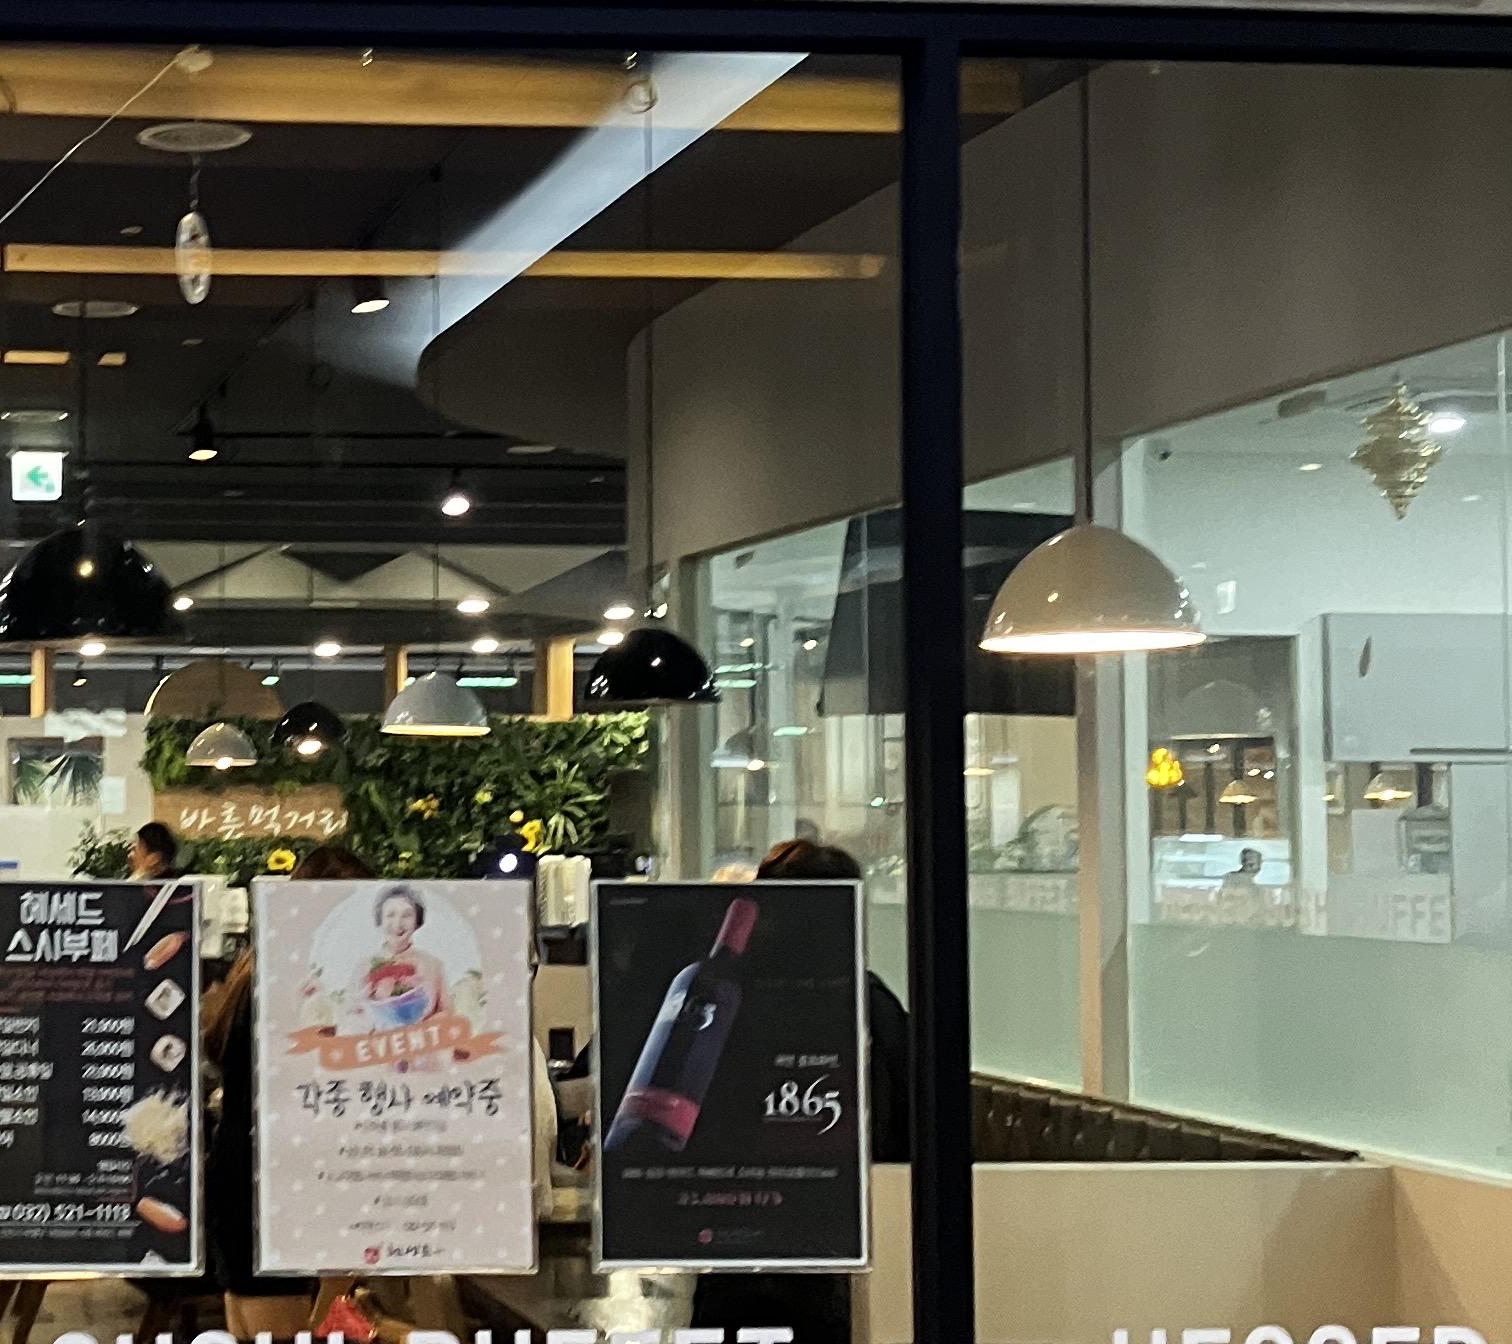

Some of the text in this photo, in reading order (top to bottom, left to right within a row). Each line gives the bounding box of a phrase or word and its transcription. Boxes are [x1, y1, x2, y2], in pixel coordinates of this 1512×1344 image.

[19, 890, 105, 926] 헤세드
[422, 1077, 503, 1116] 예약중
[763, 1074, 843, 1136] 1865
